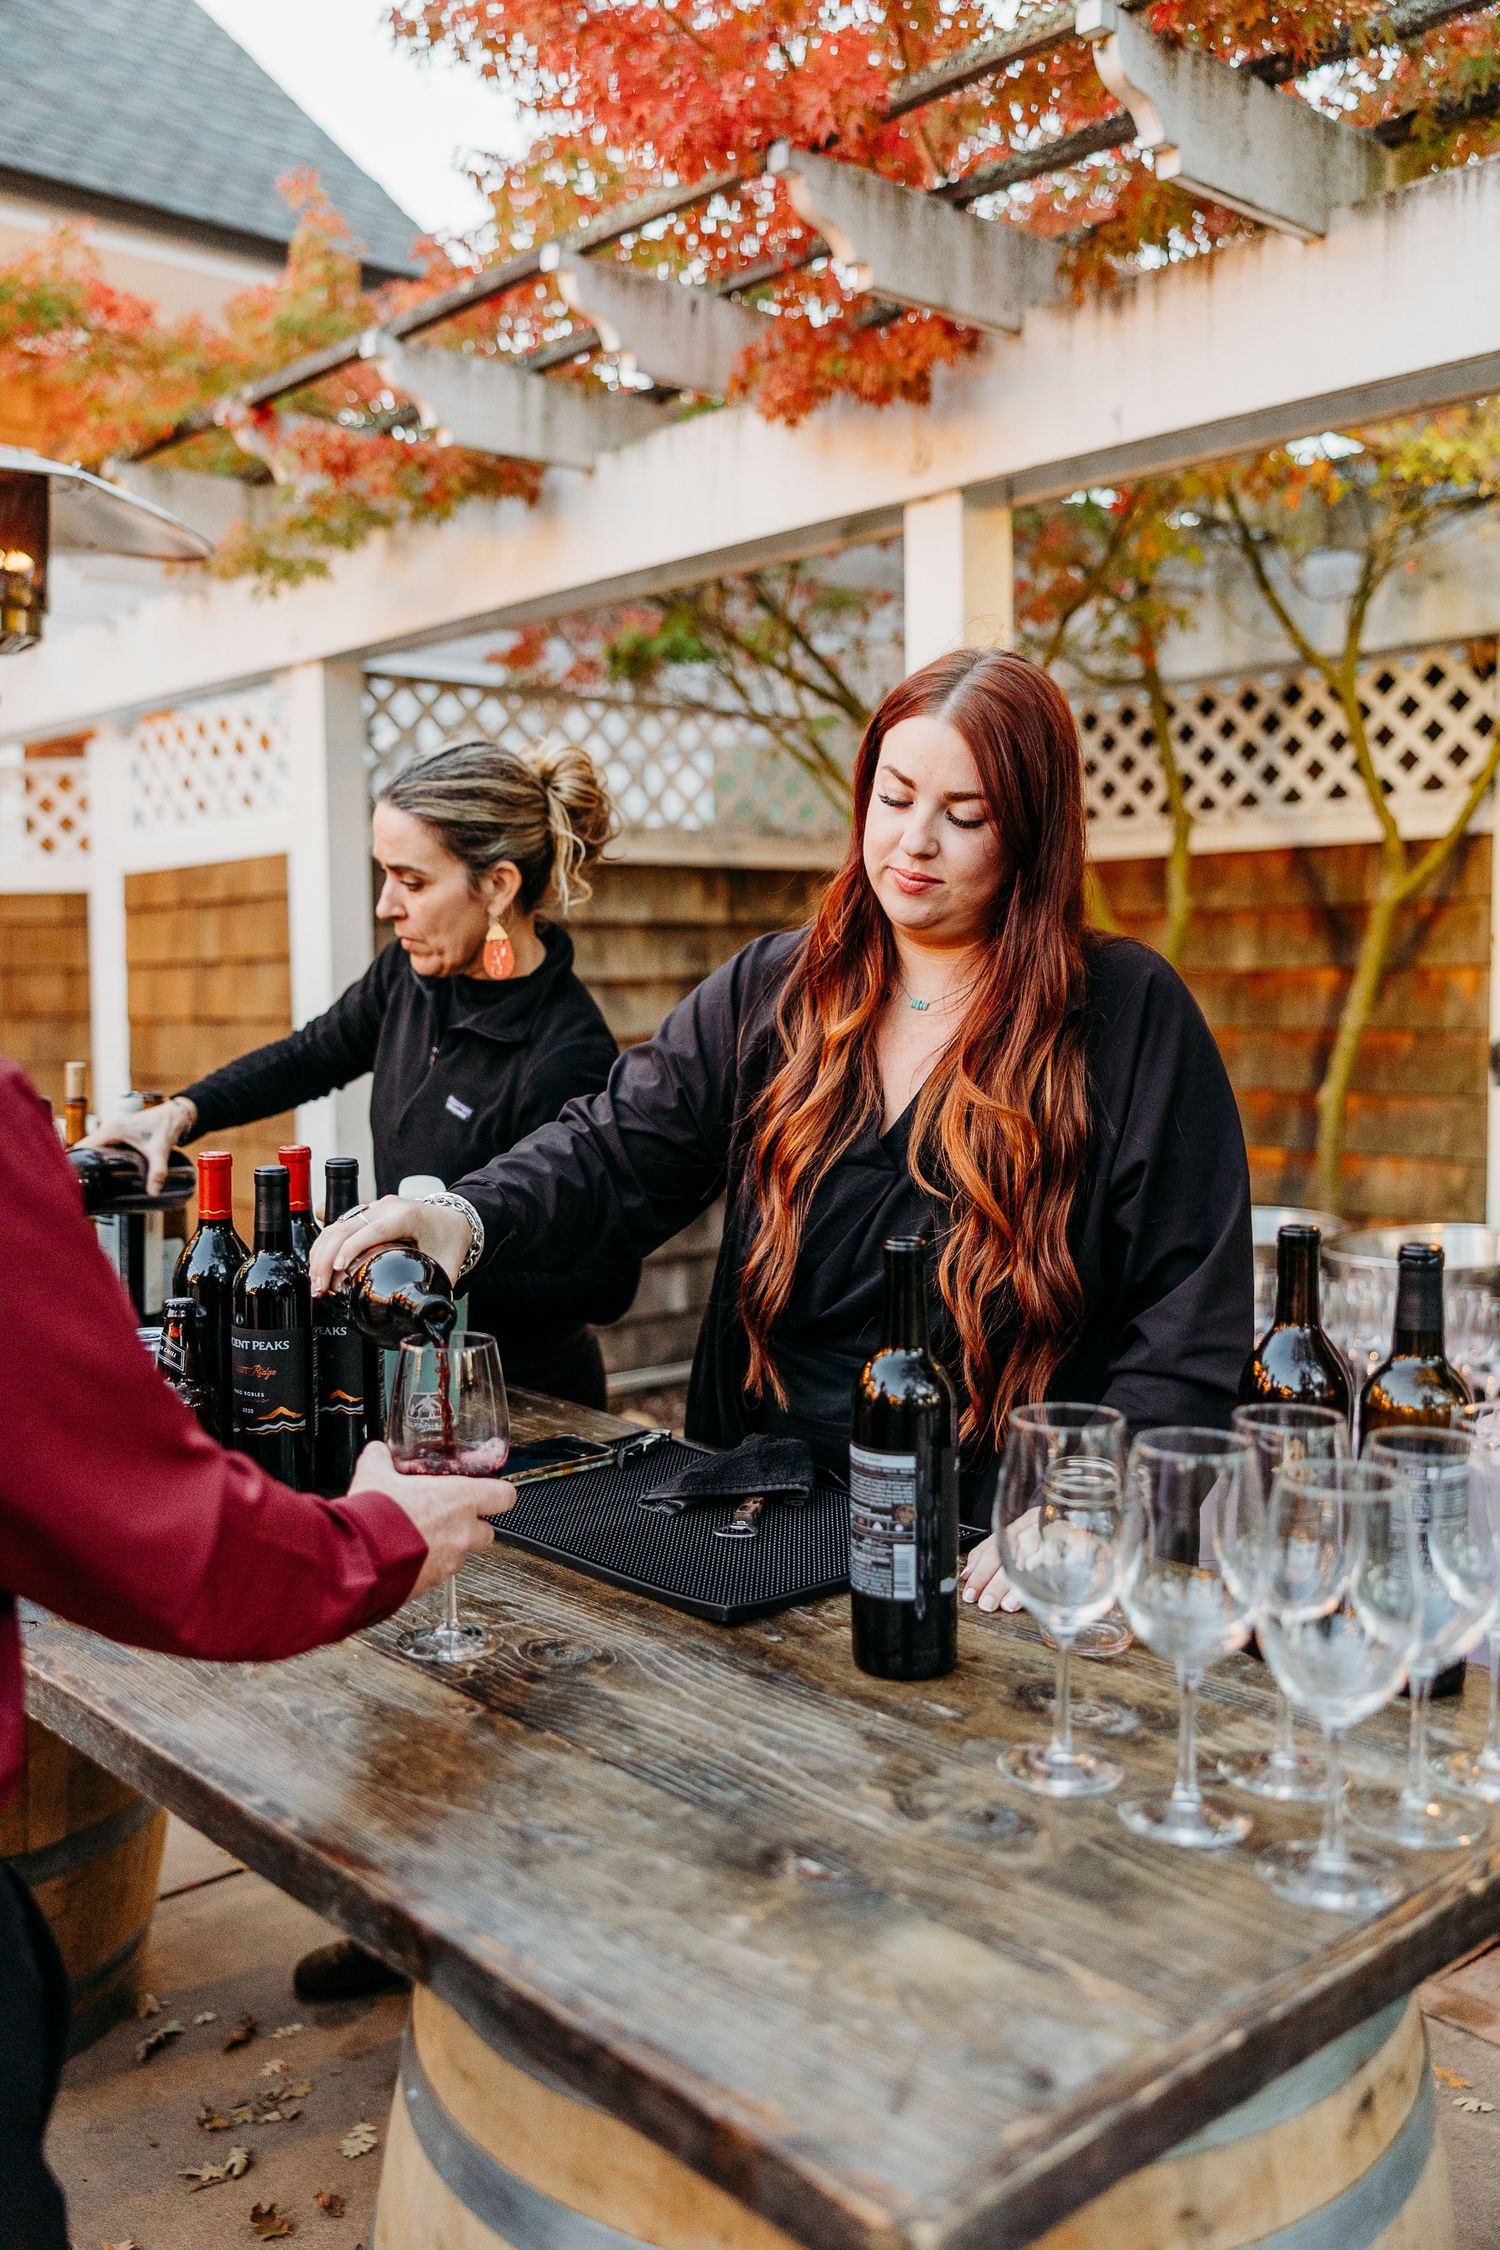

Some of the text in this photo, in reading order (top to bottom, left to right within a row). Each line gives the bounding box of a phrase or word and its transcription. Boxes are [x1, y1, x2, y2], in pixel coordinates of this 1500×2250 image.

[231, 1337, 290, 1351] CIENT PEAKS
[253, 1364, 278, 1381] Ridge
